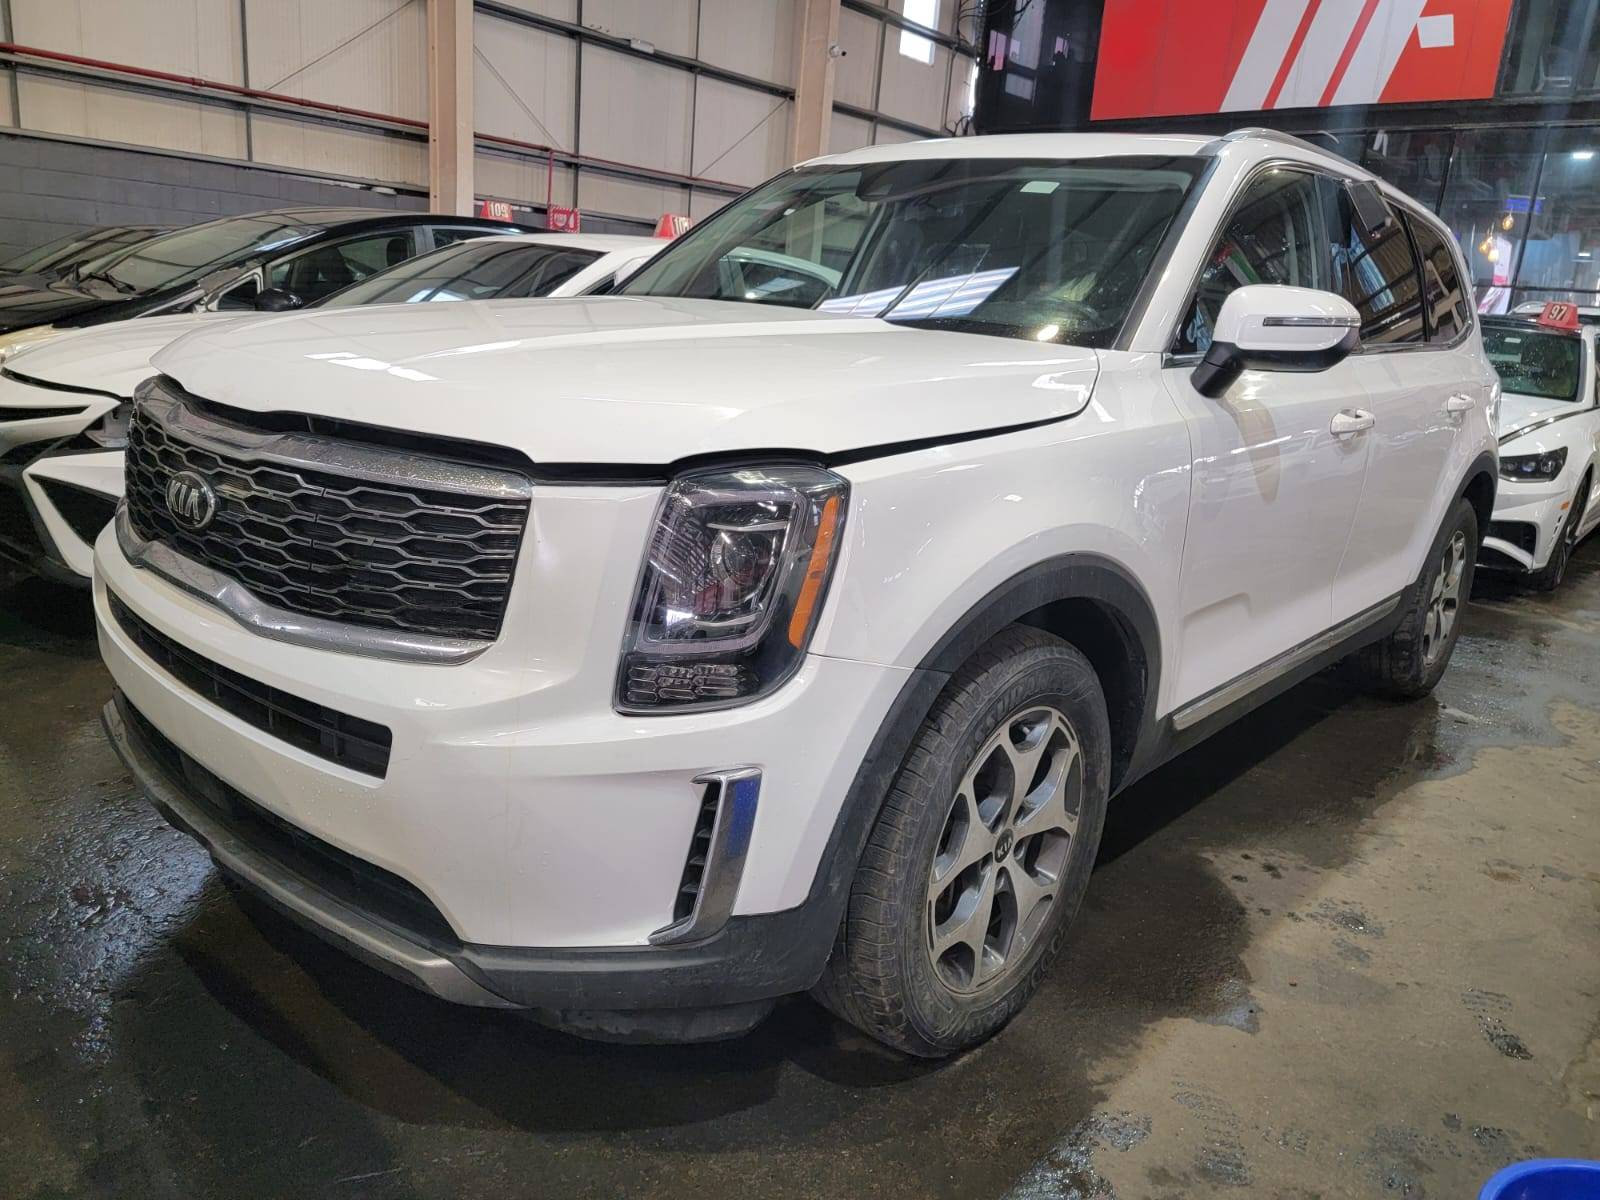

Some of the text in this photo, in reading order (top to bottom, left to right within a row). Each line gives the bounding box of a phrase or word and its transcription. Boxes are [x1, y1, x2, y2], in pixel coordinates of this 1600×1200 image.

[1549, 305, 1567, 320] 97
[168, 480, 201, 521] KIA
[997, 836, 1012, 858] KIA
